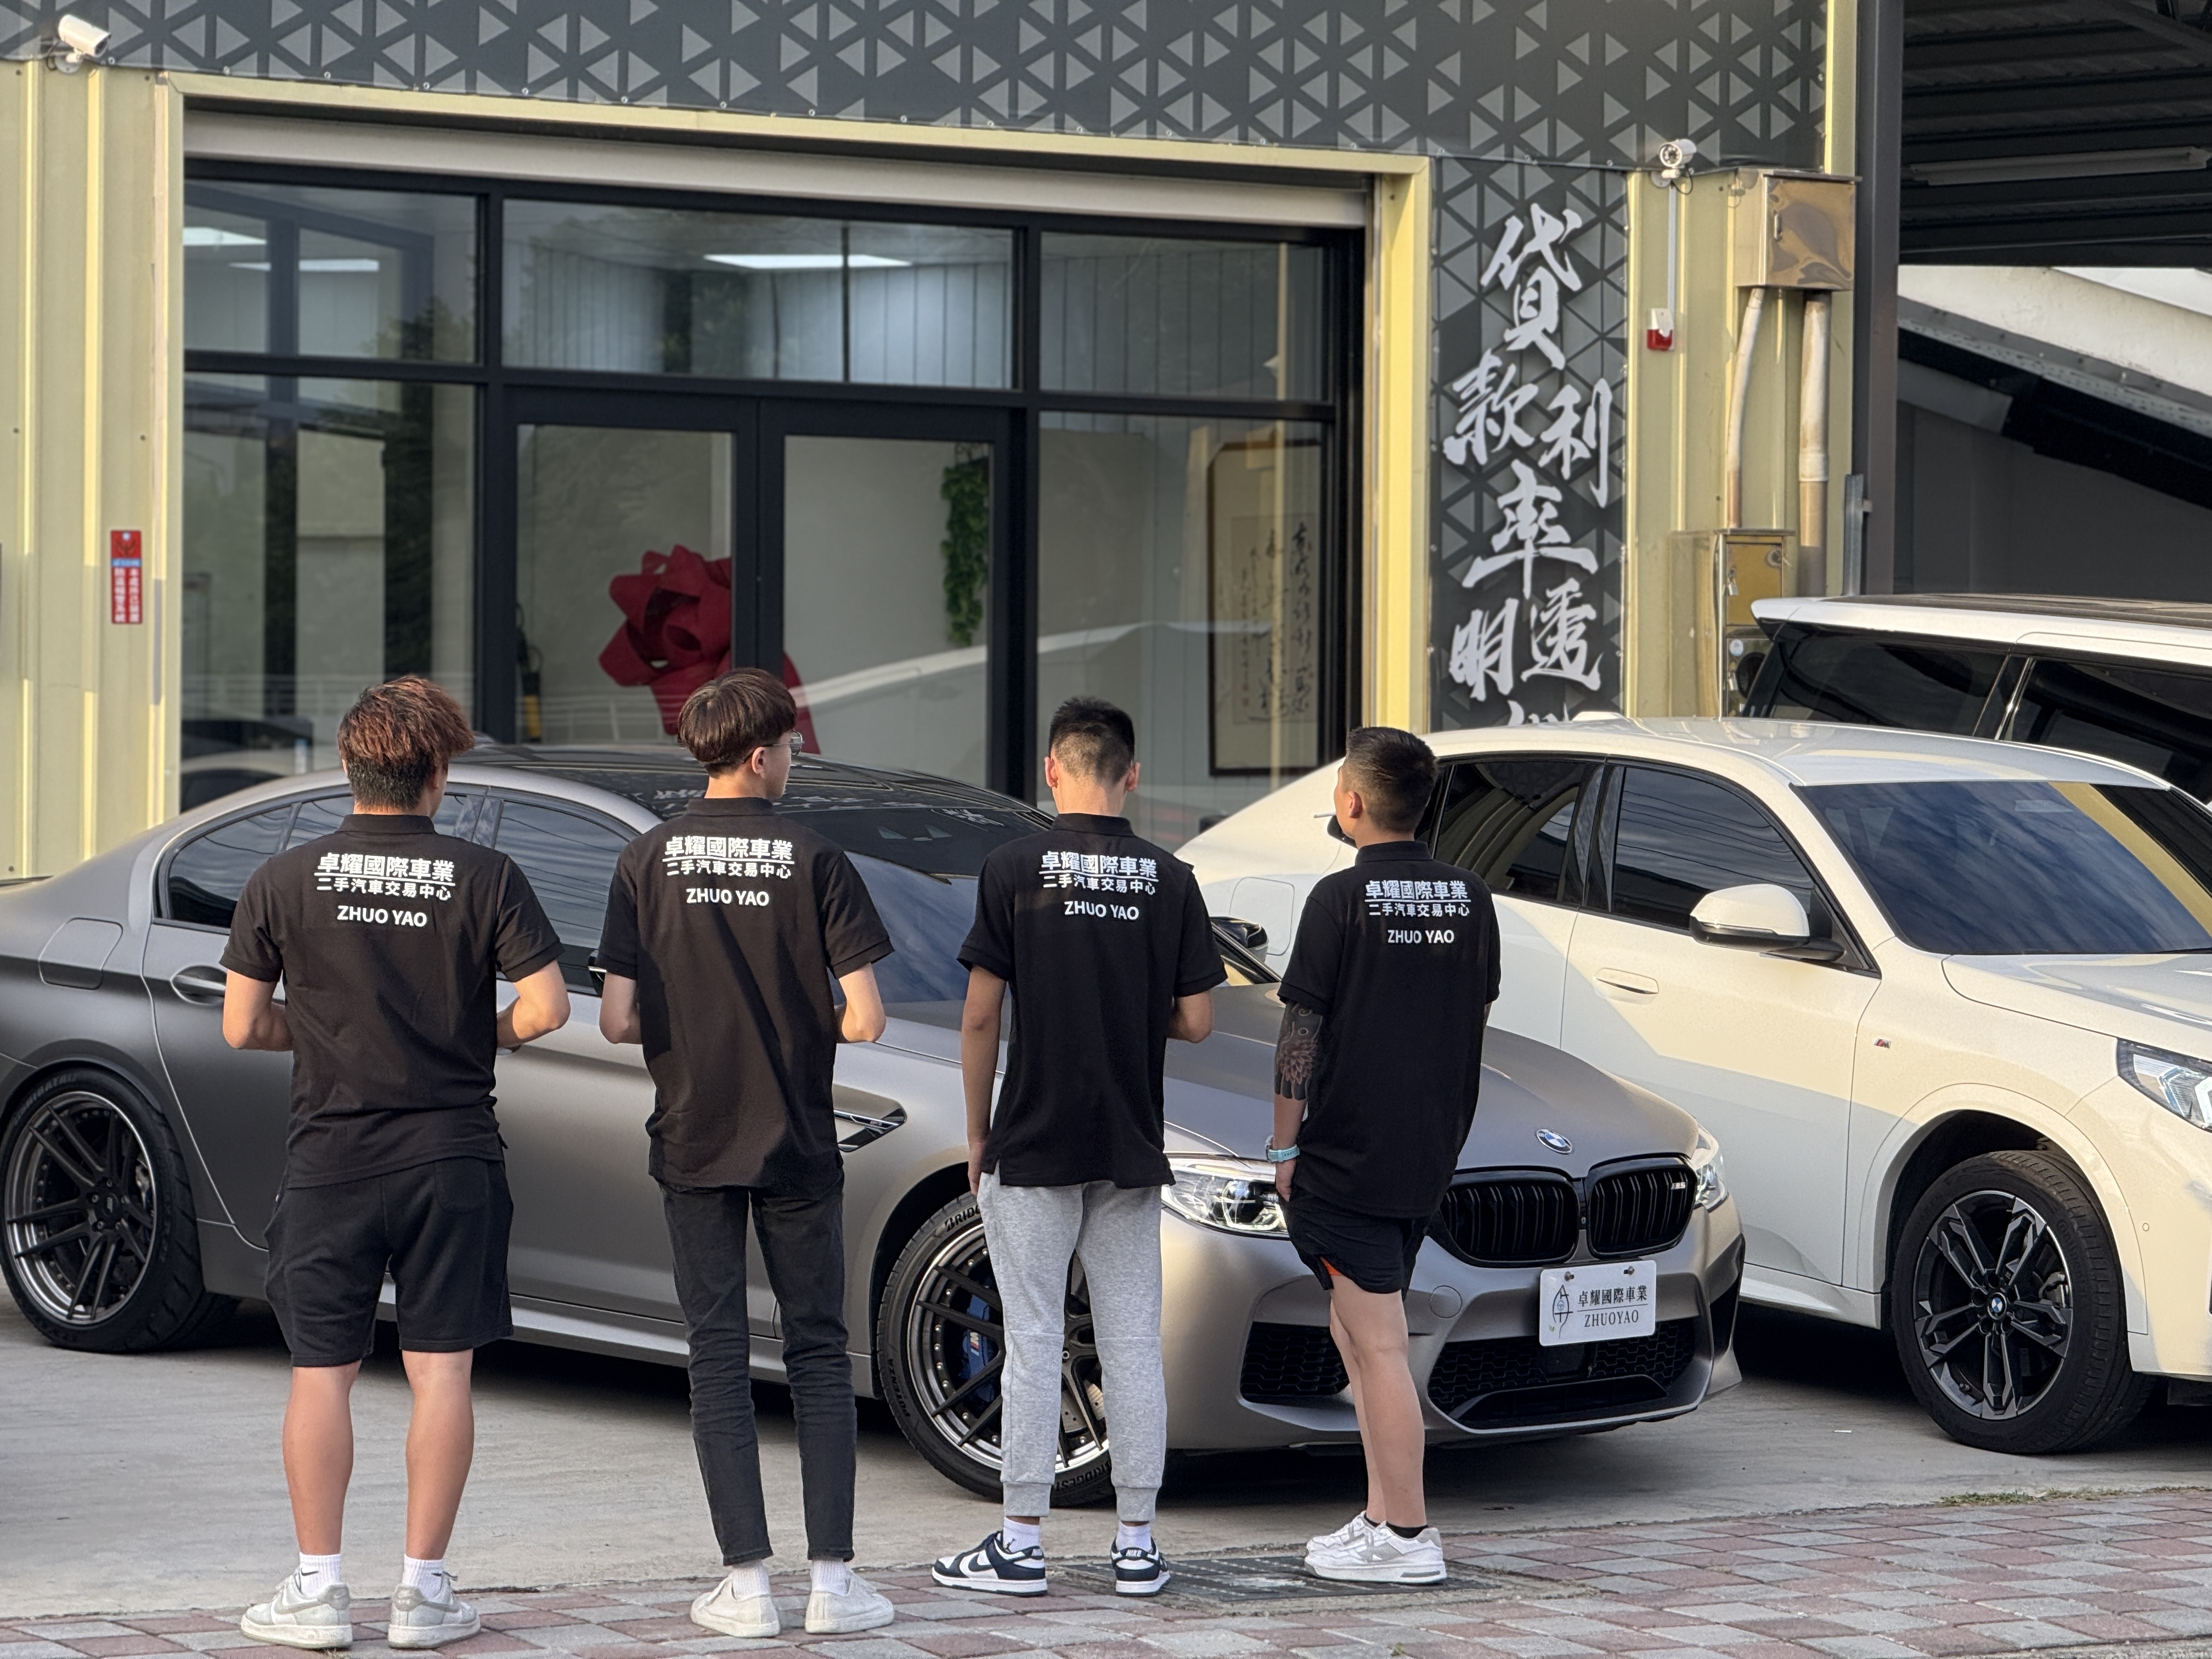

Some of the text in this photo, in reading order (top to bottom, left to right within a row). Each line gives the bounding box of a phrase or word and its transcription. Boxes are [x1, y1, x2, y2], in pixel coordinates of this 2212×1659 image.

[664, 835, 793, 860] 卓耀國際車業
[318, 853, 455, 882] 卓耀國際車業
[667, 859, 791, 879] 二手汽車交易中心
[1041, 851, 1157, 878] 卓耀國際車業
[317, 877, 452, 901] 二手汽車交易中心
[1043, 873, 1156, 895] 二手汽車交易中心
[1365, 879, 1468, 900] 卓耀國際車業
[686, 888, 770, 907] ZHUO YAO
[337, 905, 427, 927] ZHUO YAO
[1064, 900, 1139, 920] ZHUO YAO
[1369, 902, 1470, 917] 二手汽車交易中心
[1387, 929, 1454, 944] ZHUO YAO
[1578, 1285, 1648, 1307] 卓耀國際車業
[1584, 1310, 1639, 1328] ZHUOYAO
